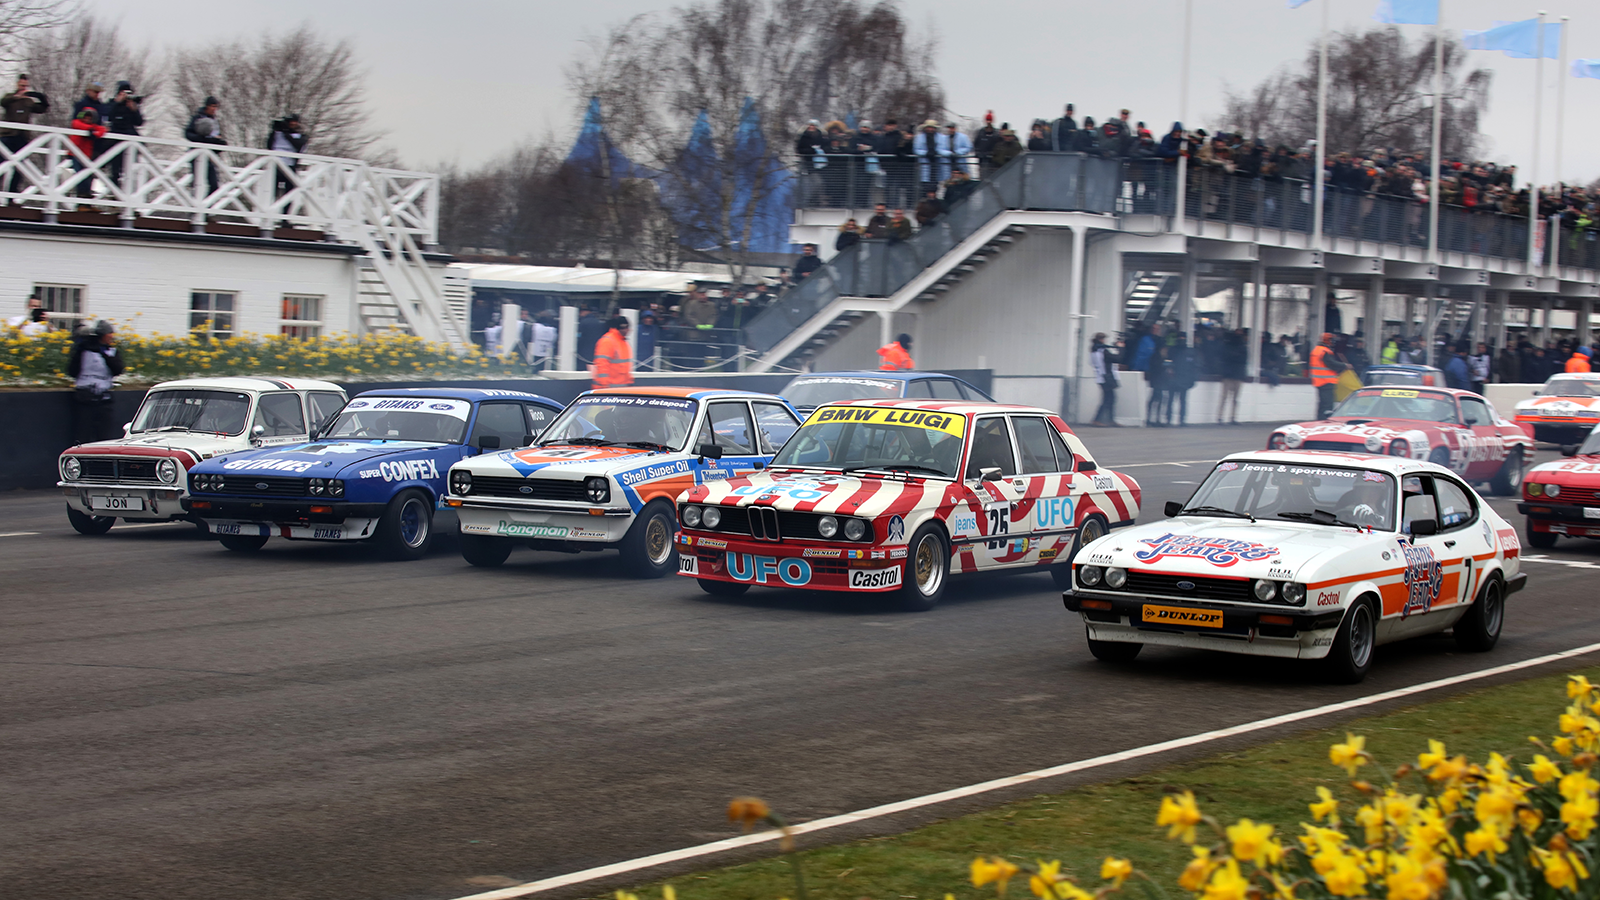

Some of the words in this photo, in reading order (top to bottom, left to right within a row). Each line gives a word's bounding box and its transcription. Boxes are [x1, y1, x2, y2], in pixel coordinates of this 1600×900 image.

[373, 400, 425, 409] GITANES
[580, 397, 600, 405] parts
[601, 397, 635, 405] delivery
[636, 398, 647, 406] by
[649, 399, 690, 409] datapost
[817, 409, 879, 422] BMW
[884, 411, 952, 430] LUIGI
[224, 459, 322, 473] GITANES
[360, 468, 381, 479] SUPER
[380, 459, 440, 482] CONFEX
[622, 469, 648, 486] Shell
[649, 464, 676, 480] Super
[676, 460, 690, 472] Oil
[1242, 463, 1274, 472] jeans
[1276, 465, 1287, 473] &
[1289, 466, 1358, 479] sportswear
[1560, 463, 1600, 472] BA
[1093, 475, 1115, 489] Castrol
[734, 486, 822, 499] UFO
[105, 498, 128, 508] JON
[1037, 497, 1074, 527] UFO
[216, 524, 241, 535] GITANES
[500, 521, 567, 537] Longman
[955, 515, 976, 535] jeans
[988, 508, 1009, 550] 25
[313, 529, 342, 538] GITANES
[726, 551, 812, 586] UFO
[852, 567, 899, 587] Castrol
[1462, 557, 1472, 603] 7
[1317, 591, 1341, 606] Castrol
[1157, 609, 1221, 622] DUNLOP
